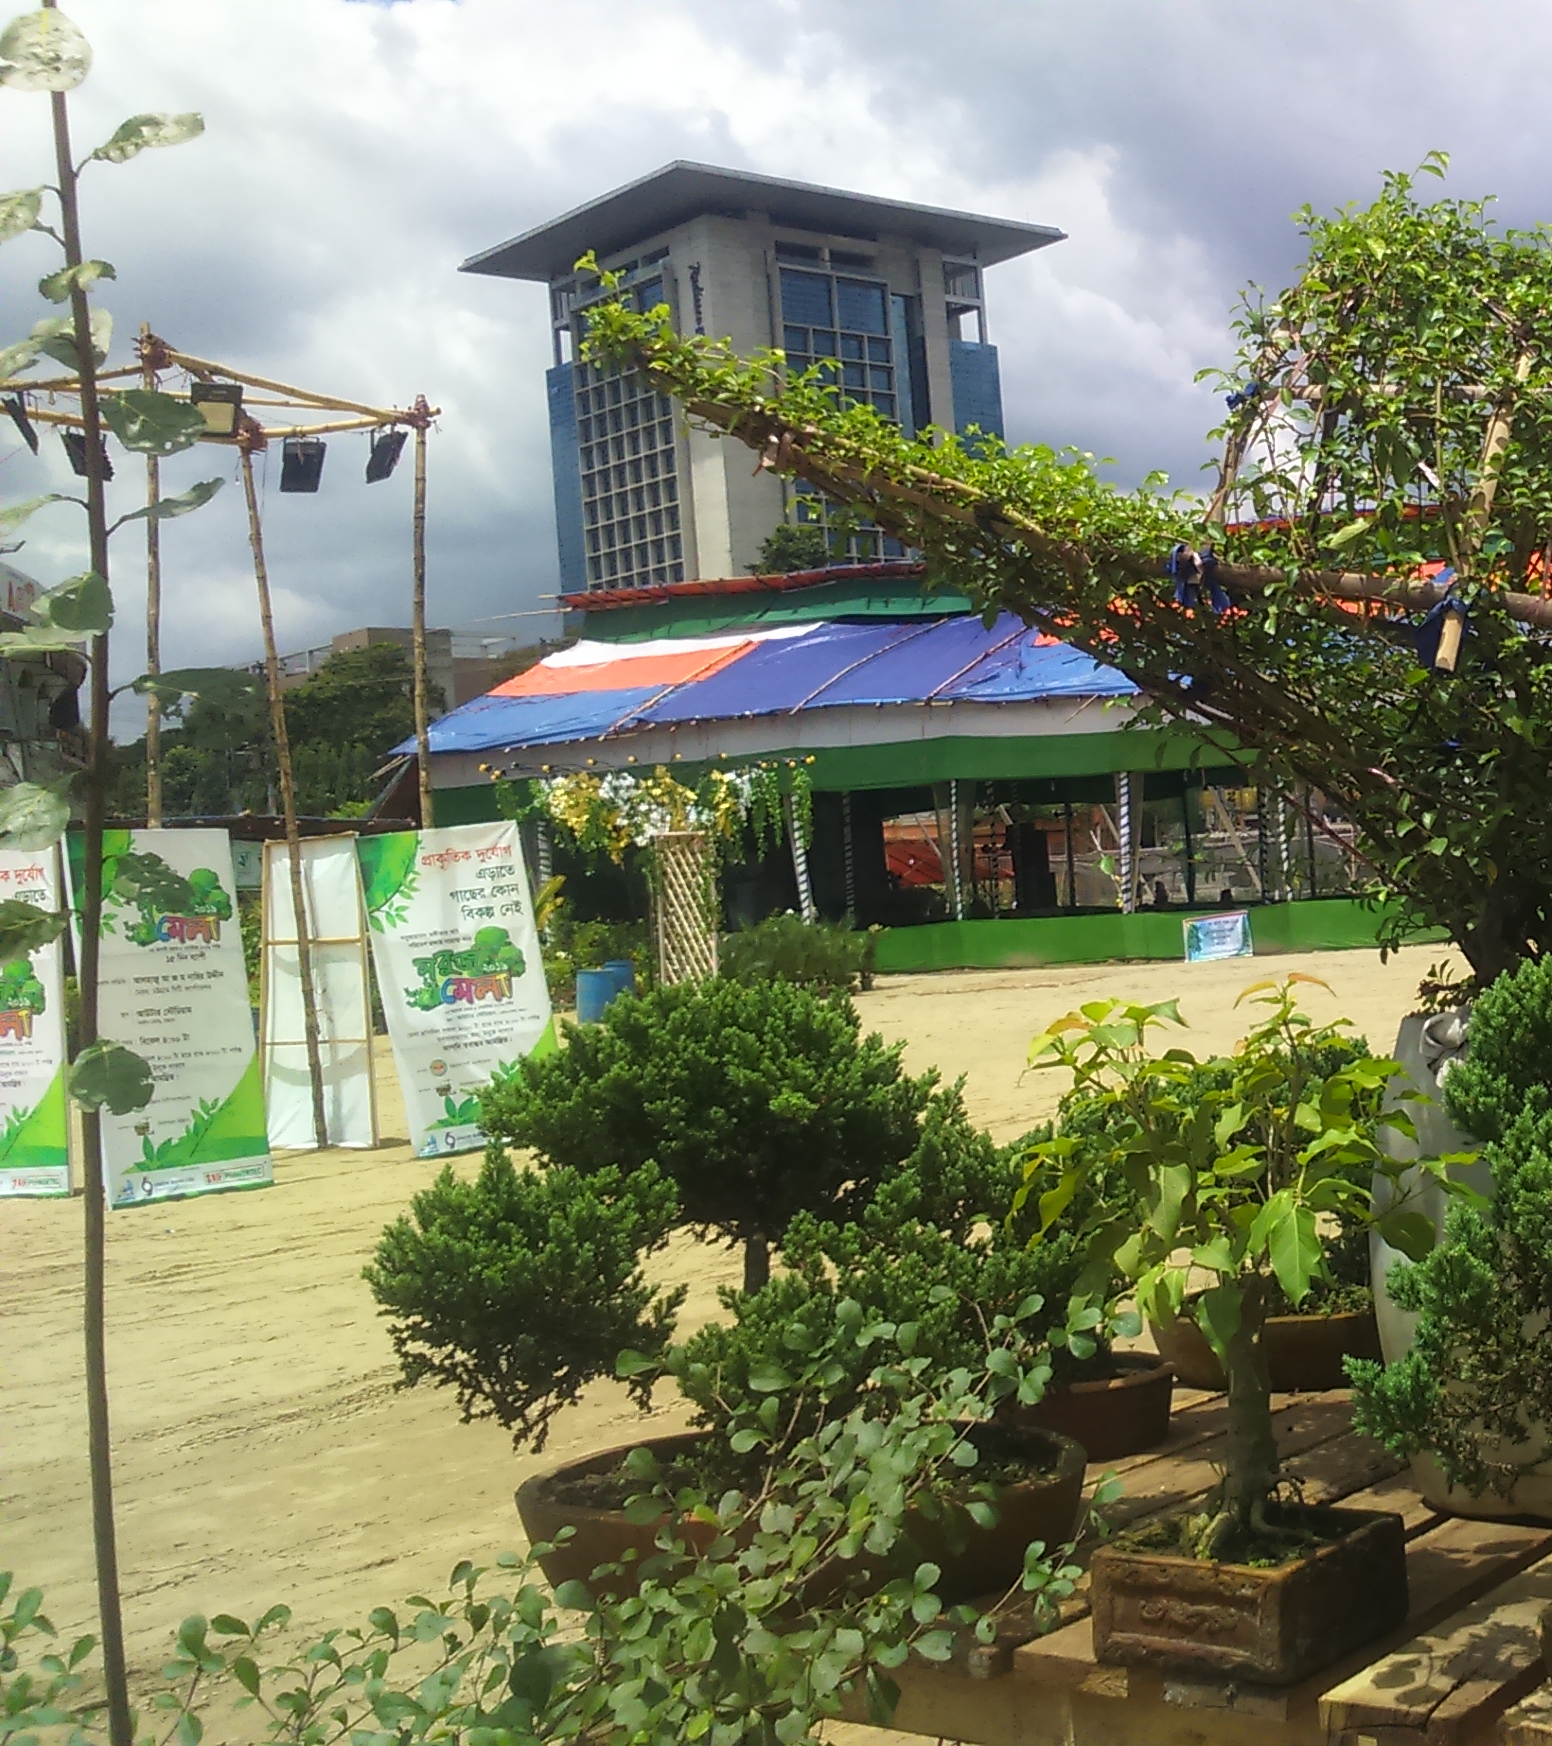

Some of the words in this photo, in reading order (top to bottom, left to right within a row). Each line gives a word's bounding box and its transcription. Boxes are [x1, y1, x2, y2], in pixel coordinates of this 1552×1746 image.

[421, 847, 472, 870] প্রাকৃতিক
[476, 843, 512, 863] দুর্যোগ
[476, 864, 515, 881] এড়াতে
[450, 887, 485, 903] গাছের
[491, 883, 519, 898] কোন
[461, 905, 495, 921] বিকল্প
[500, 900, 524, 917] নেই
[156, 915, 221, 943] মেলা
[440, 972, 513, 1005] মেলা
